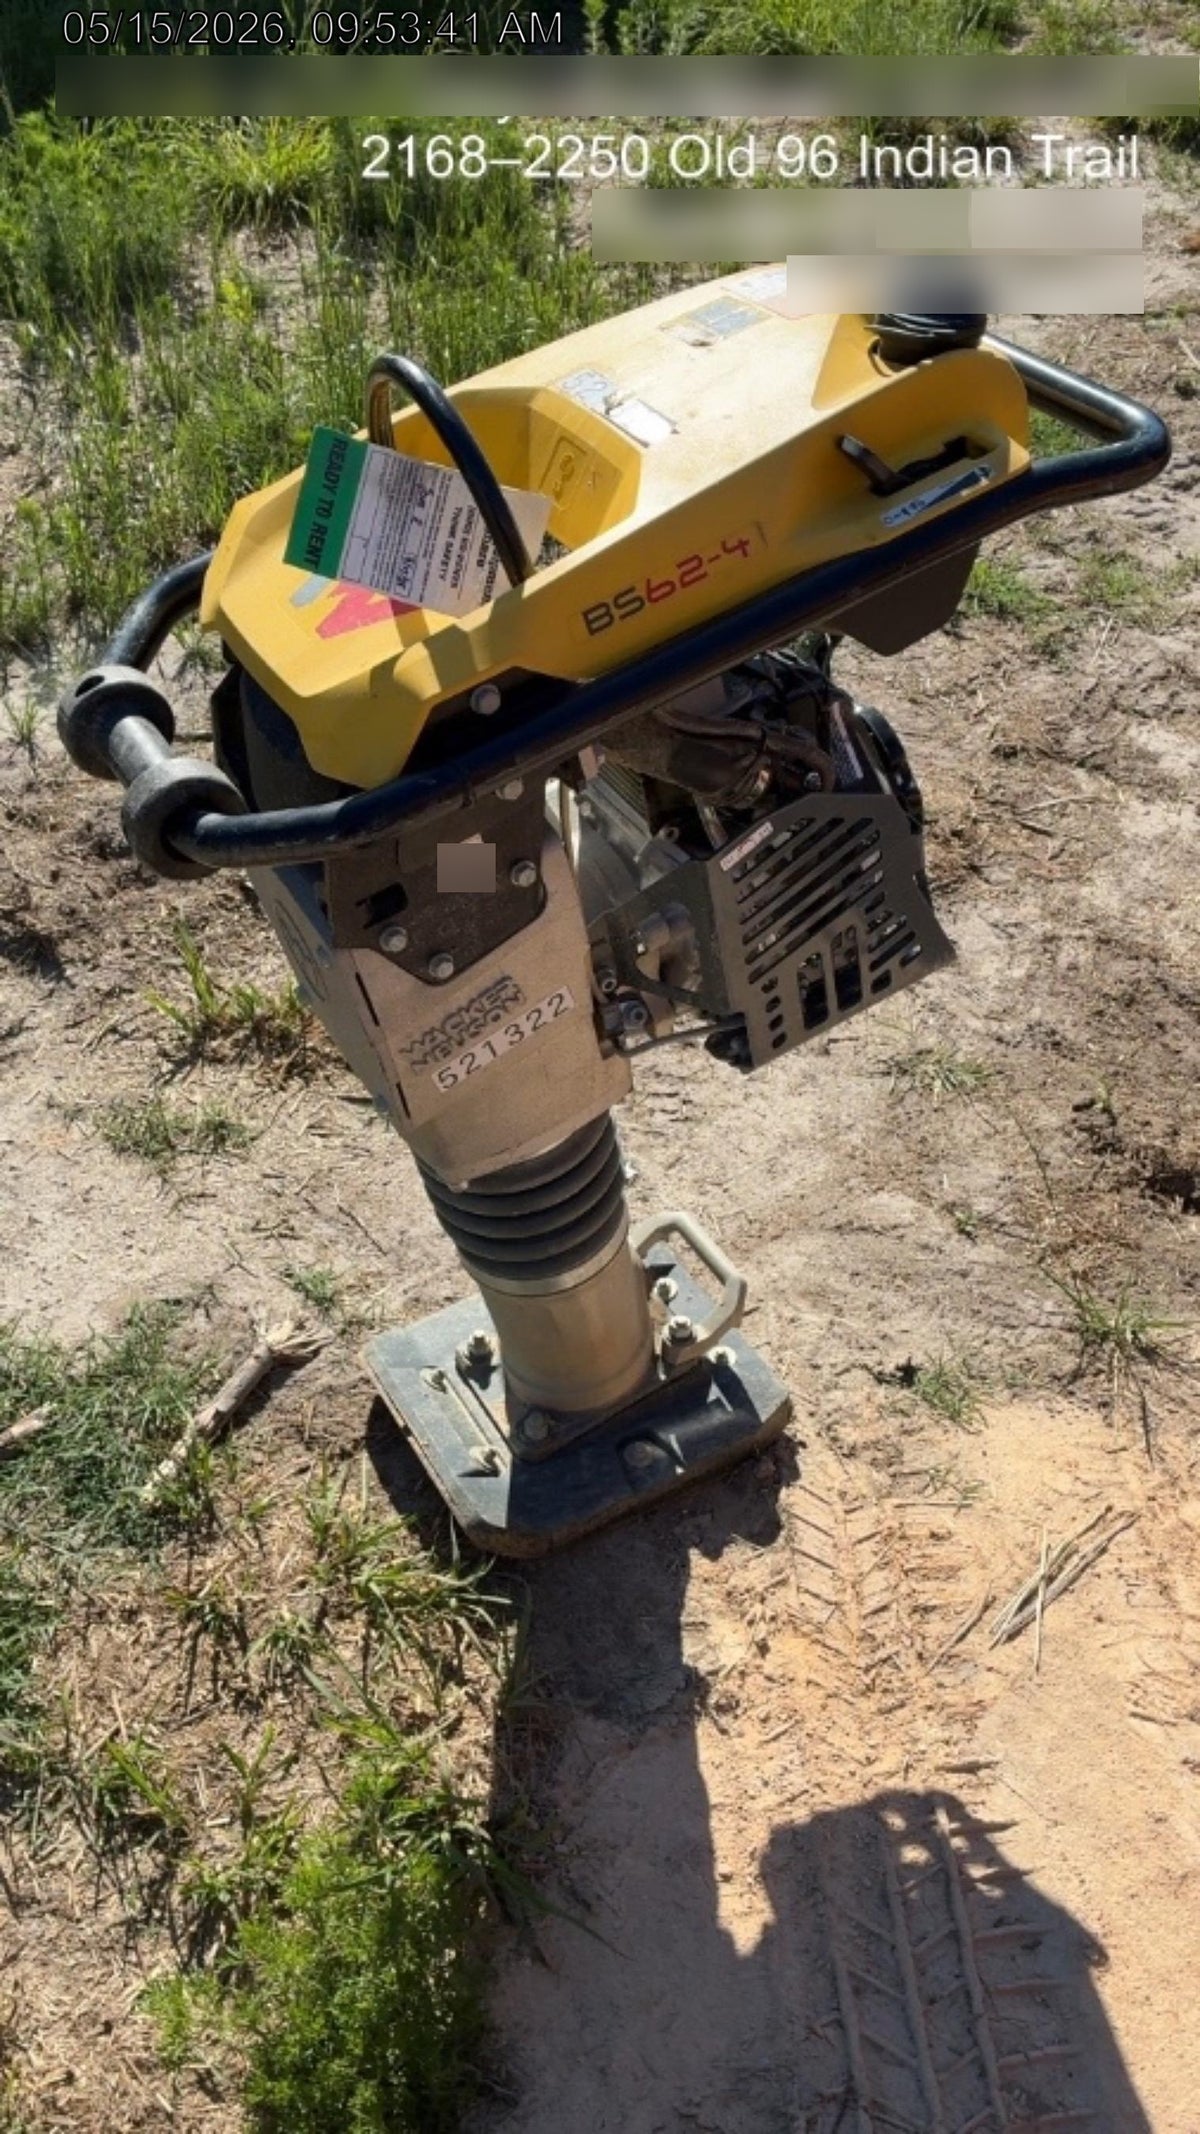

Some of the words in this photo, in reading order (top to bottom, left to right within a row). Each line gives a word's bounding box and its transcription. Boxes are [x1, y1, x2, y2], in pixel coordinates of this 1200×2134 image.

[323, 437, 348, 495] READY
[314, 498, 335, 521] TO
[303, 521, 329, 570] RENT
[581, 538, 750, 636] BS62-4
[437, 992, 570, 1090] 521322
